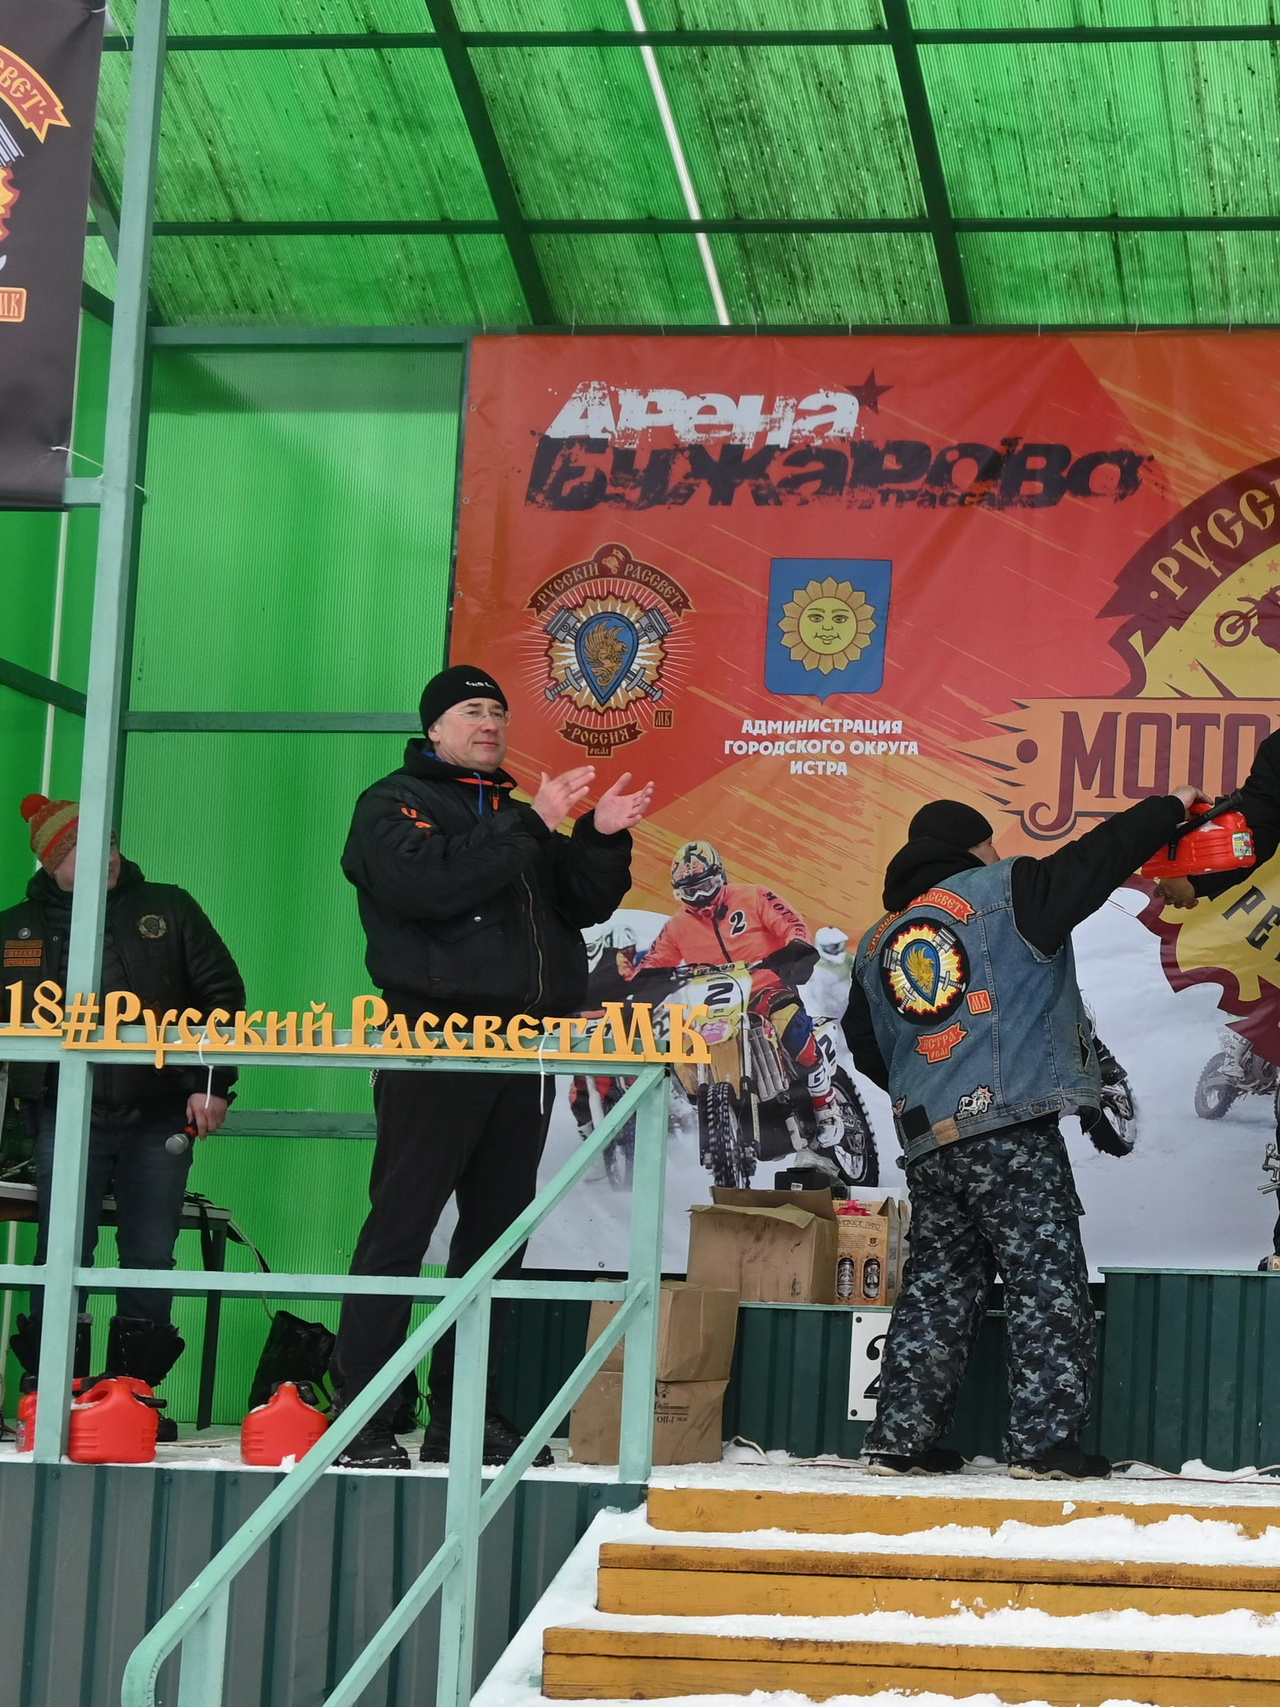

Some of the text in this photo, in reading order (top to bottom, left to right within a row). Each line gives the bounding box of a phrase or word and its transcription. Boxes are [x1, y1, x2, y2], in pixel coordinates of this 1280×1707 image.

[624, 562, 683, 607] РАССВЕТ
[655, 711, 671, 727] МК
[741, 718, 903, 736] АДМИНИСТРАЦИЯ
[571, 727, 630, 745] РОССИЯ
[724, 740, 919, 756] ГОРОДСКОГО ОКРУГА
[789, 760, 848, 776] ИСТРА
[729, 910, 747, 936] 2
[704, 982, 734, 1007] 2
